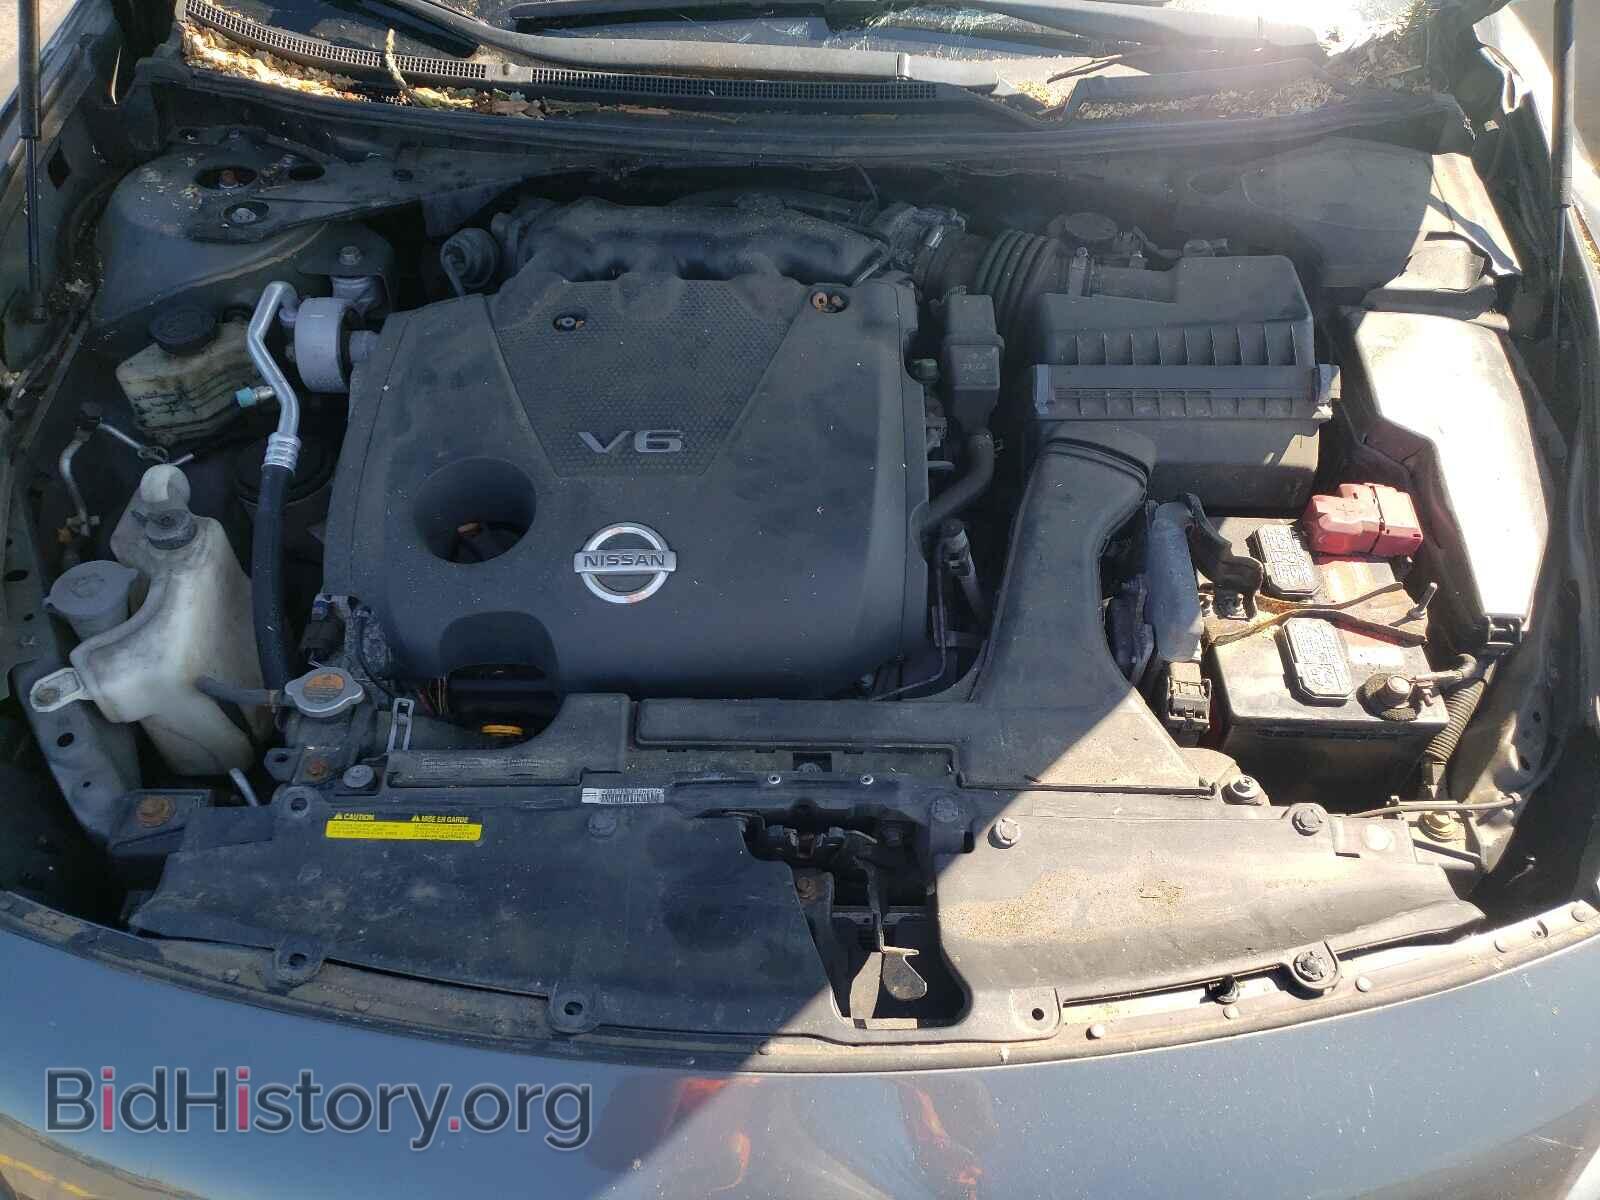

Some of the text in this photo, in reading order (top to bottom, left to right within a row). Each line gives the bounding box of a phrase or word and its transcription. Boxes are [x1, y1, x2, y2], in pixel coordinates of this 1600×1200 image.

[578, 429, 682, 453] V6
[583, 553, 665, 567] NISSAN
[343, 813, 375, 821] CAUTION
[421, 815, 436, 823] MISE
[446, 816, 469, 824] GARDE
